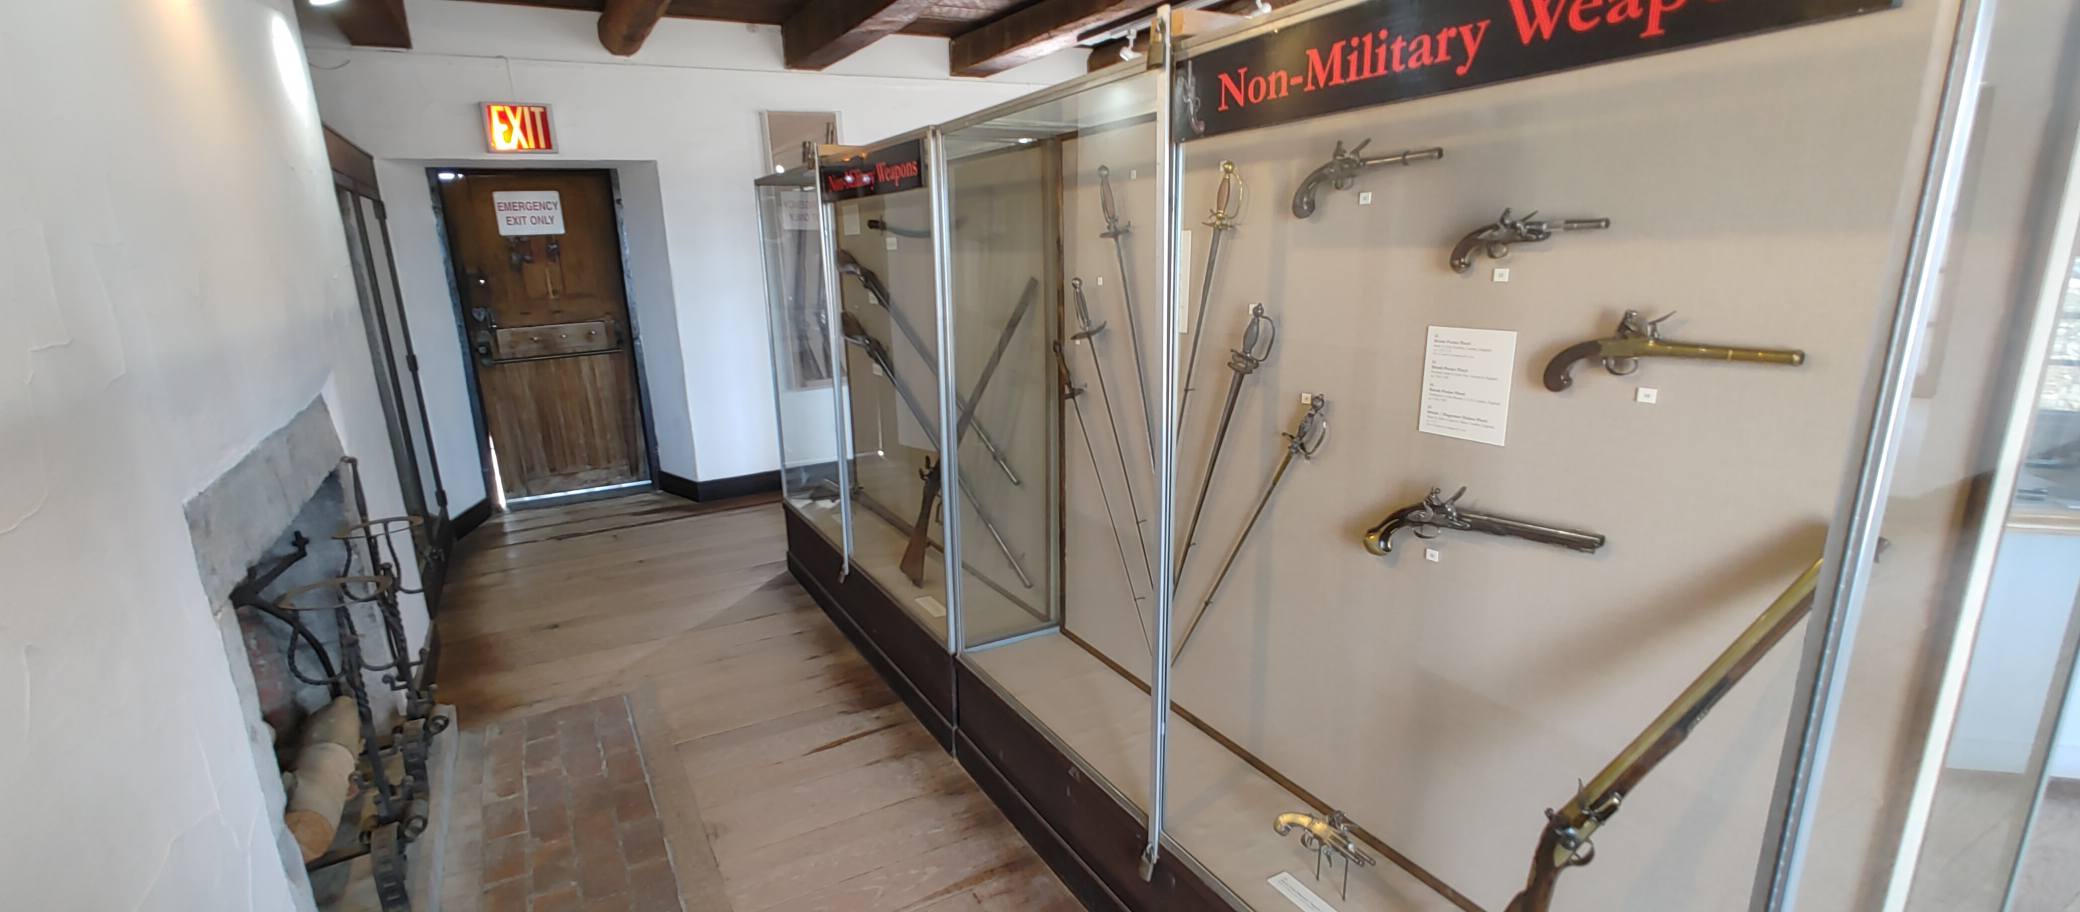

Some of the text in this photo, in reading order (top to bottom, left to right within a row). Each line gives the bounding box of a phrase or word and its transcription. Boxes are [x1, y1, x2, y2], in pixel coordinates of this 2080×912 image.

[1217, 0, 1723, 112] Non-Military Weap
[489, 105, 546, 150] EXIT
[876, 161, 918, 187] Weapons
[497, 201, 559, 212] EMERGENCY
[506, 215, 555, 226] EXIT ONLY
